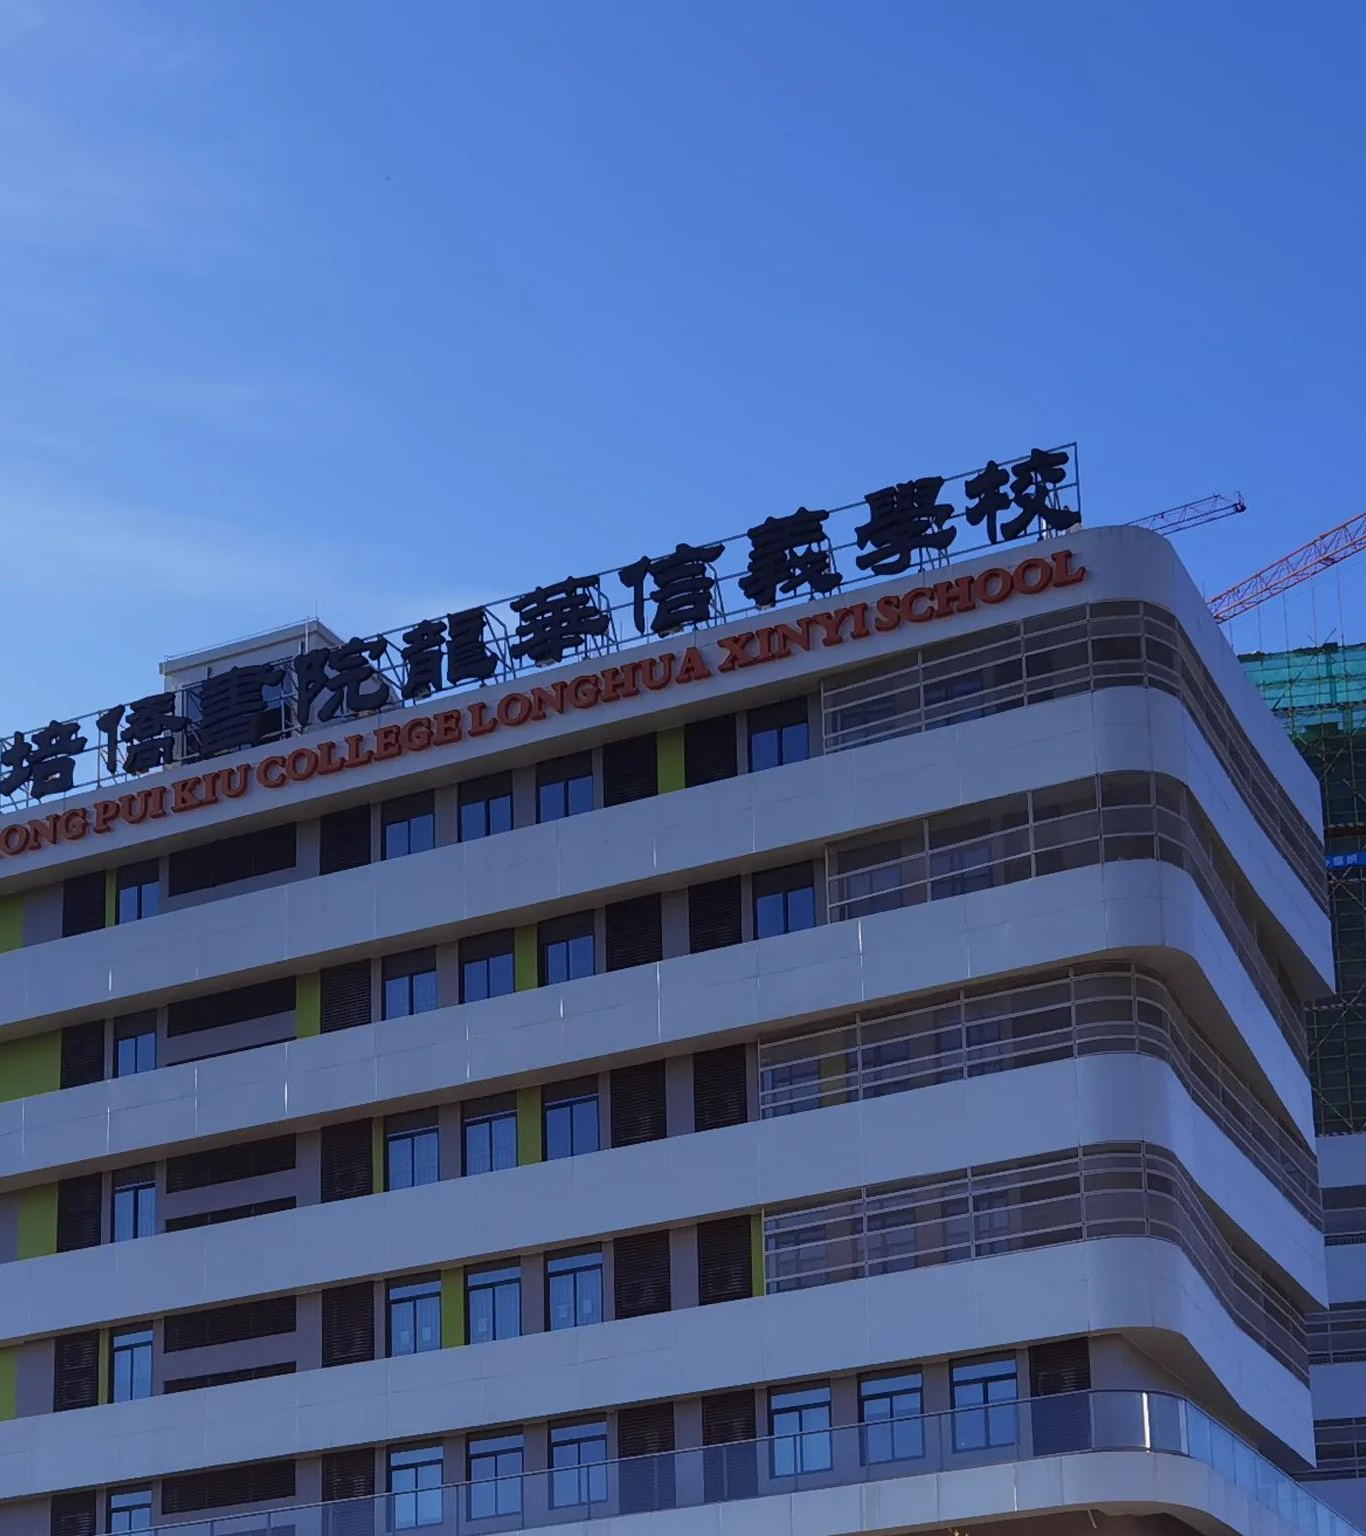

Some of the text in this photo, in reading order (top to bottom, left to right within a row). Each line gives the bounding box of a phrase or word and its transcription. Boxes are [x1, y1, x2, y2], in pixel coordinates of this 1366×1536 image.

[93, 785, 167, 835] PUI
[171, 763, 252, 814] KIU
[256, 704, 462, 789] COLLEGE
[467, 647, 710, 737] LONGHUA
[718, 602, 870, 673] XINYI
[874, 550, 1087, 632] SCHOOL
